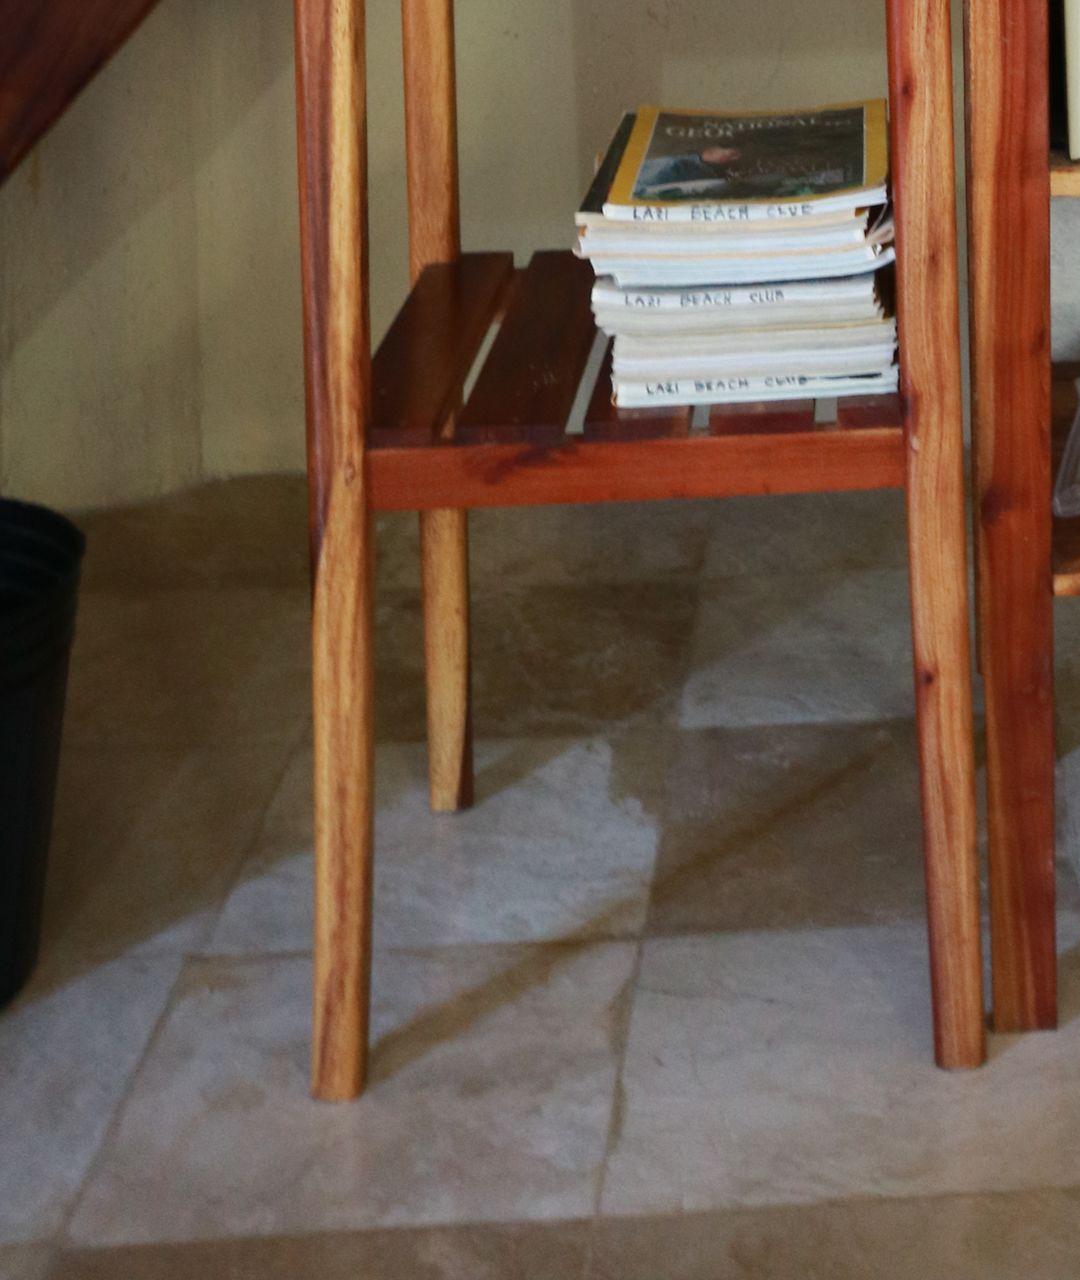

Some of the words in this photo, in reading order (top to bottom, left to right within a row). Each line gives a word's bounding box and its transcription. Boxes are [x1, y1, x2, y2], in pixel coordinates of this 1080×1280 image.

[691, 204, 750, 221] BEACH
[680, 292, 732, 307] BEACH
[695, 379, 749, 391] BEACH
